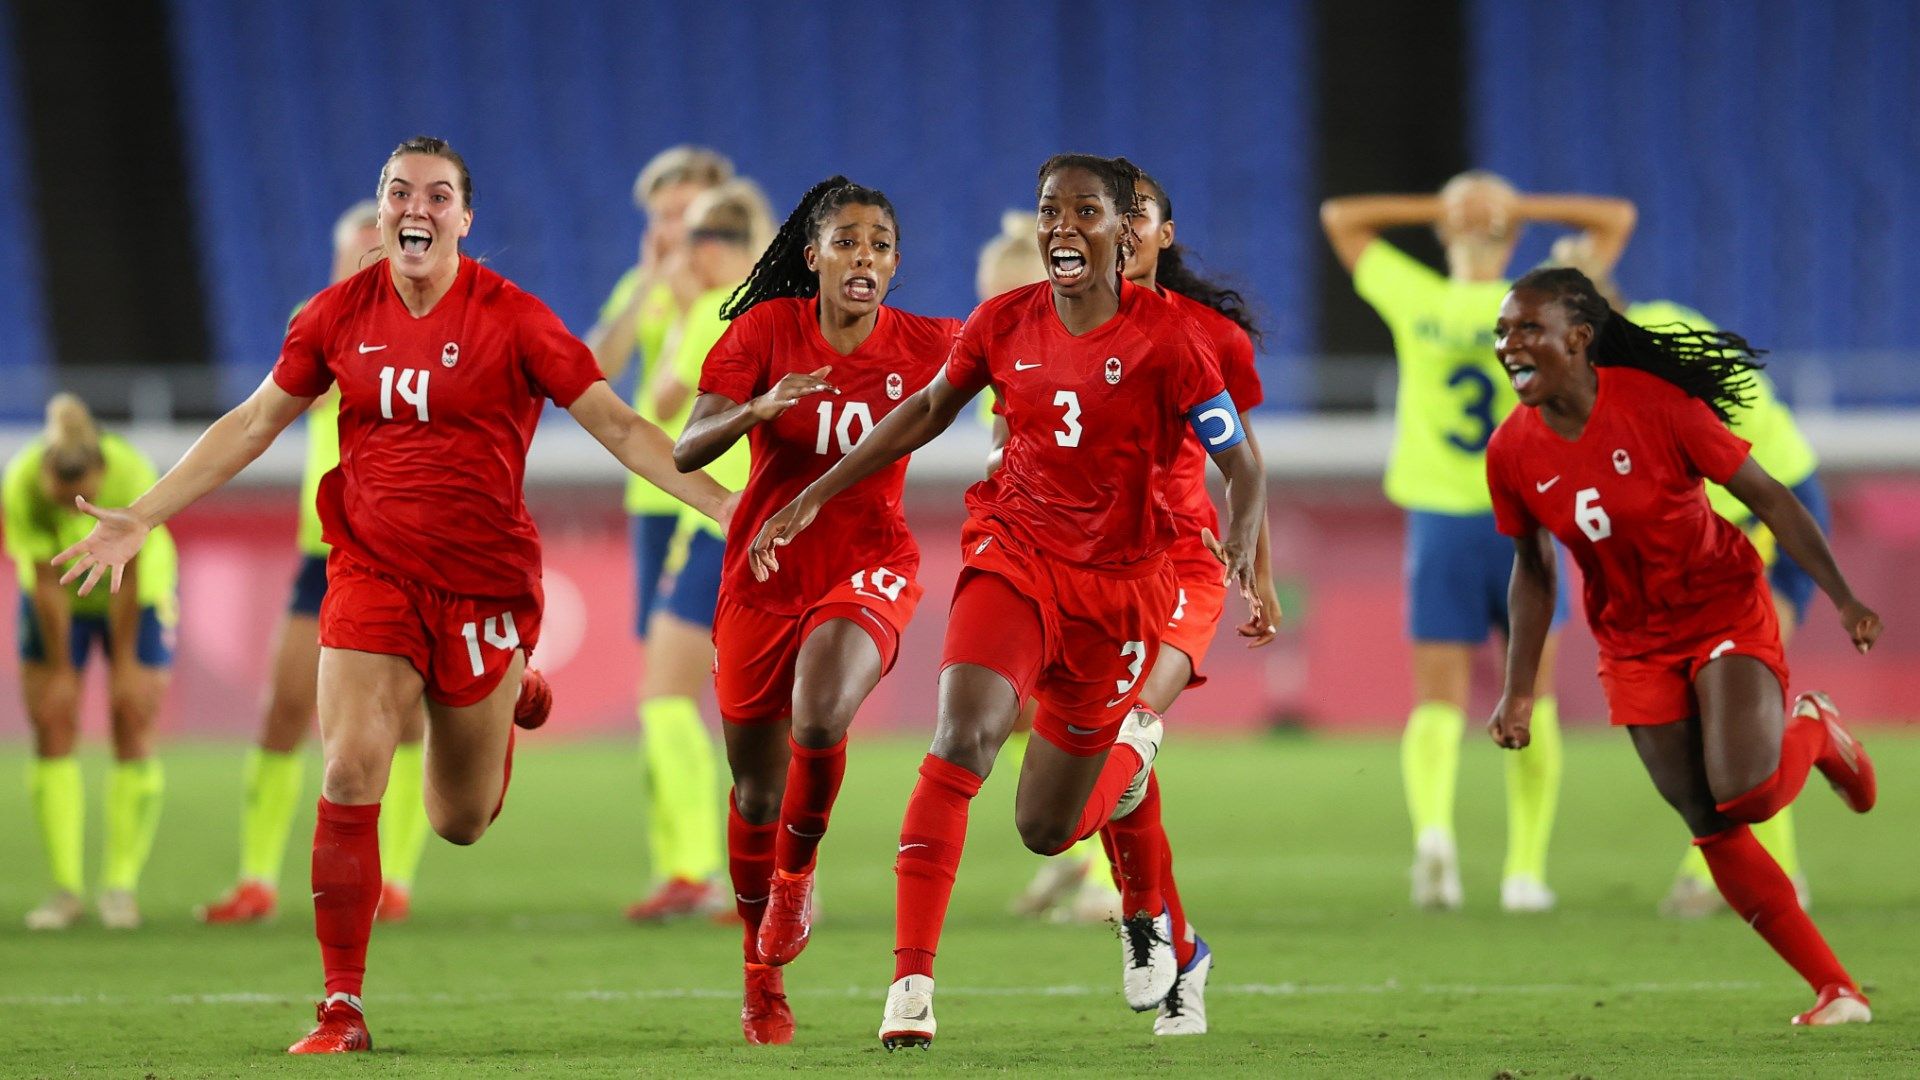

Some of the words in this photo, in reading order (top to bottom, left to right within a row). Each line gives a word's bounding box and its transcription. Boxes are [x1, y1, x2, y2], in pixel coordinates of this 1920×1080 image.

[379, 366, 430, 422] 14
[1053, 390, 1083, 448] 3
[1448, 366, 1495, 453] 3
[815, 401, 874, 455] 10
[1198, 407, 1235, 446] C
[1575, 487, 1612, 543] 6
[461, 611, 520, 677] 14
[1116, 640, 1146, 694] 3
